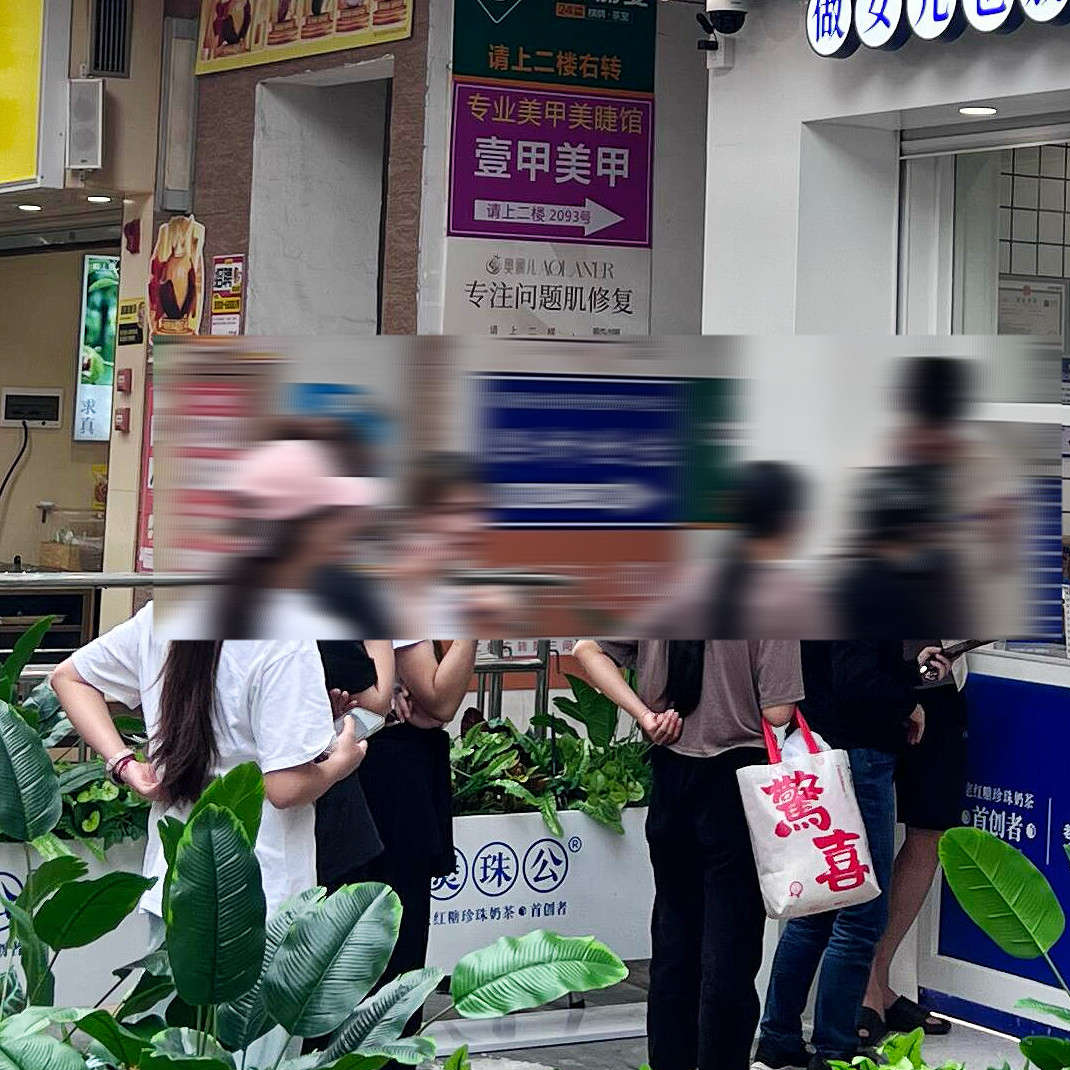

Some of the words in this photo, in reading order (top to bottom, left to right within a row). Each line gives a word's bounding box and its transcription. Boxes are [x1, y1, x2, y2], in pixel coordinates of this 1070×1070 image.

[488, 44, 622, 81] 请上二楼右转
[466, 92, 643, 135] 专业美甲美睫馆
[473, 136, 630, 188] 壹甲美甲
[486, 203, 546, 222] 请上二楼
[549, 209, 592, 225] 2093号
[464, 280, 633, 315] 专注问题肌修复
[964, 781, 1035, 809] 老红糖珍珠奶茶
[971, 804, 1025, 843] 首创者
[431, 905, 517, 926] 红糖珍珠奶茶
[531, 901, 568, 918] 首创者
